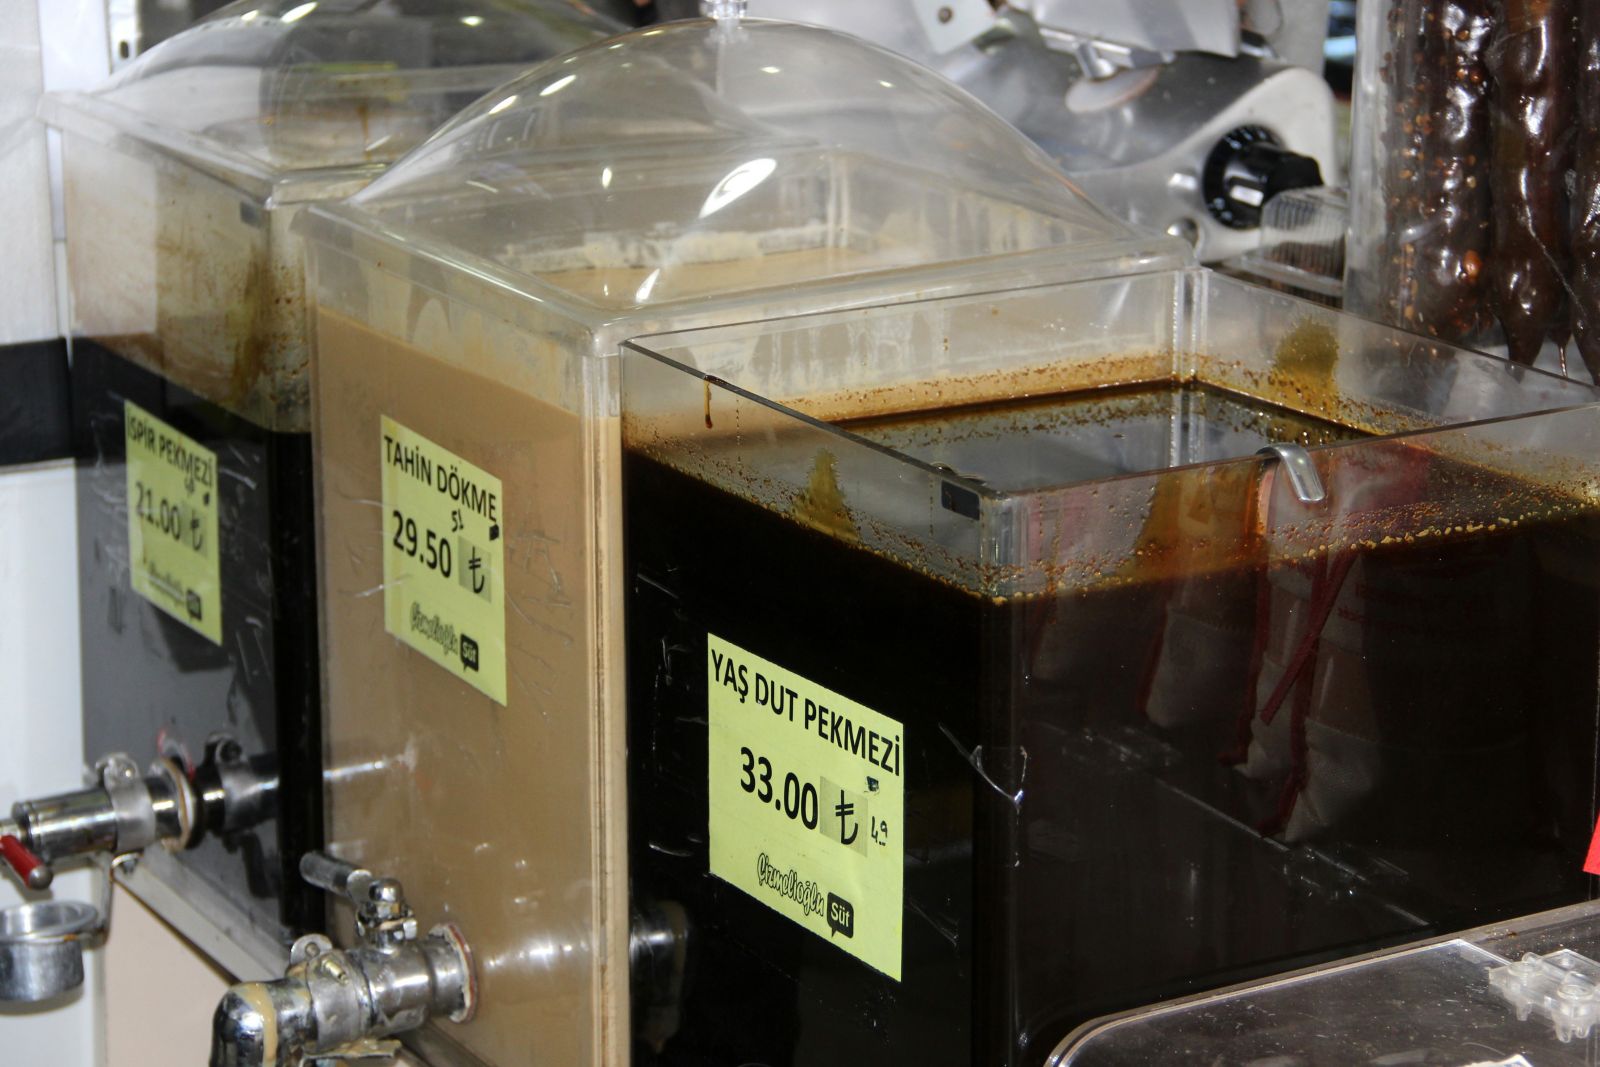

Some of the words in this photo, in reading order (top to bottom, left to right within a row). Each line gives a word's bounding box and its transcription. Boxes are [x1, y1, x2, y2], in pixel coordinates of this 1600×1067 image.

[136, 481, 181, 541] 21.00
[384, 434, 431, 487] TAHİN
[437, 464, 497, 523] DÖKME
[393, 510, 452, 579] 29.50
[711, 648, 749, 704] YAŞ
[755, 672, 798, 722] DUT
[804, 698, 900, 776] PEKMEZİ
[740, 746, 818, 831] 33.00
[830, 902, 850, 928] Süt
